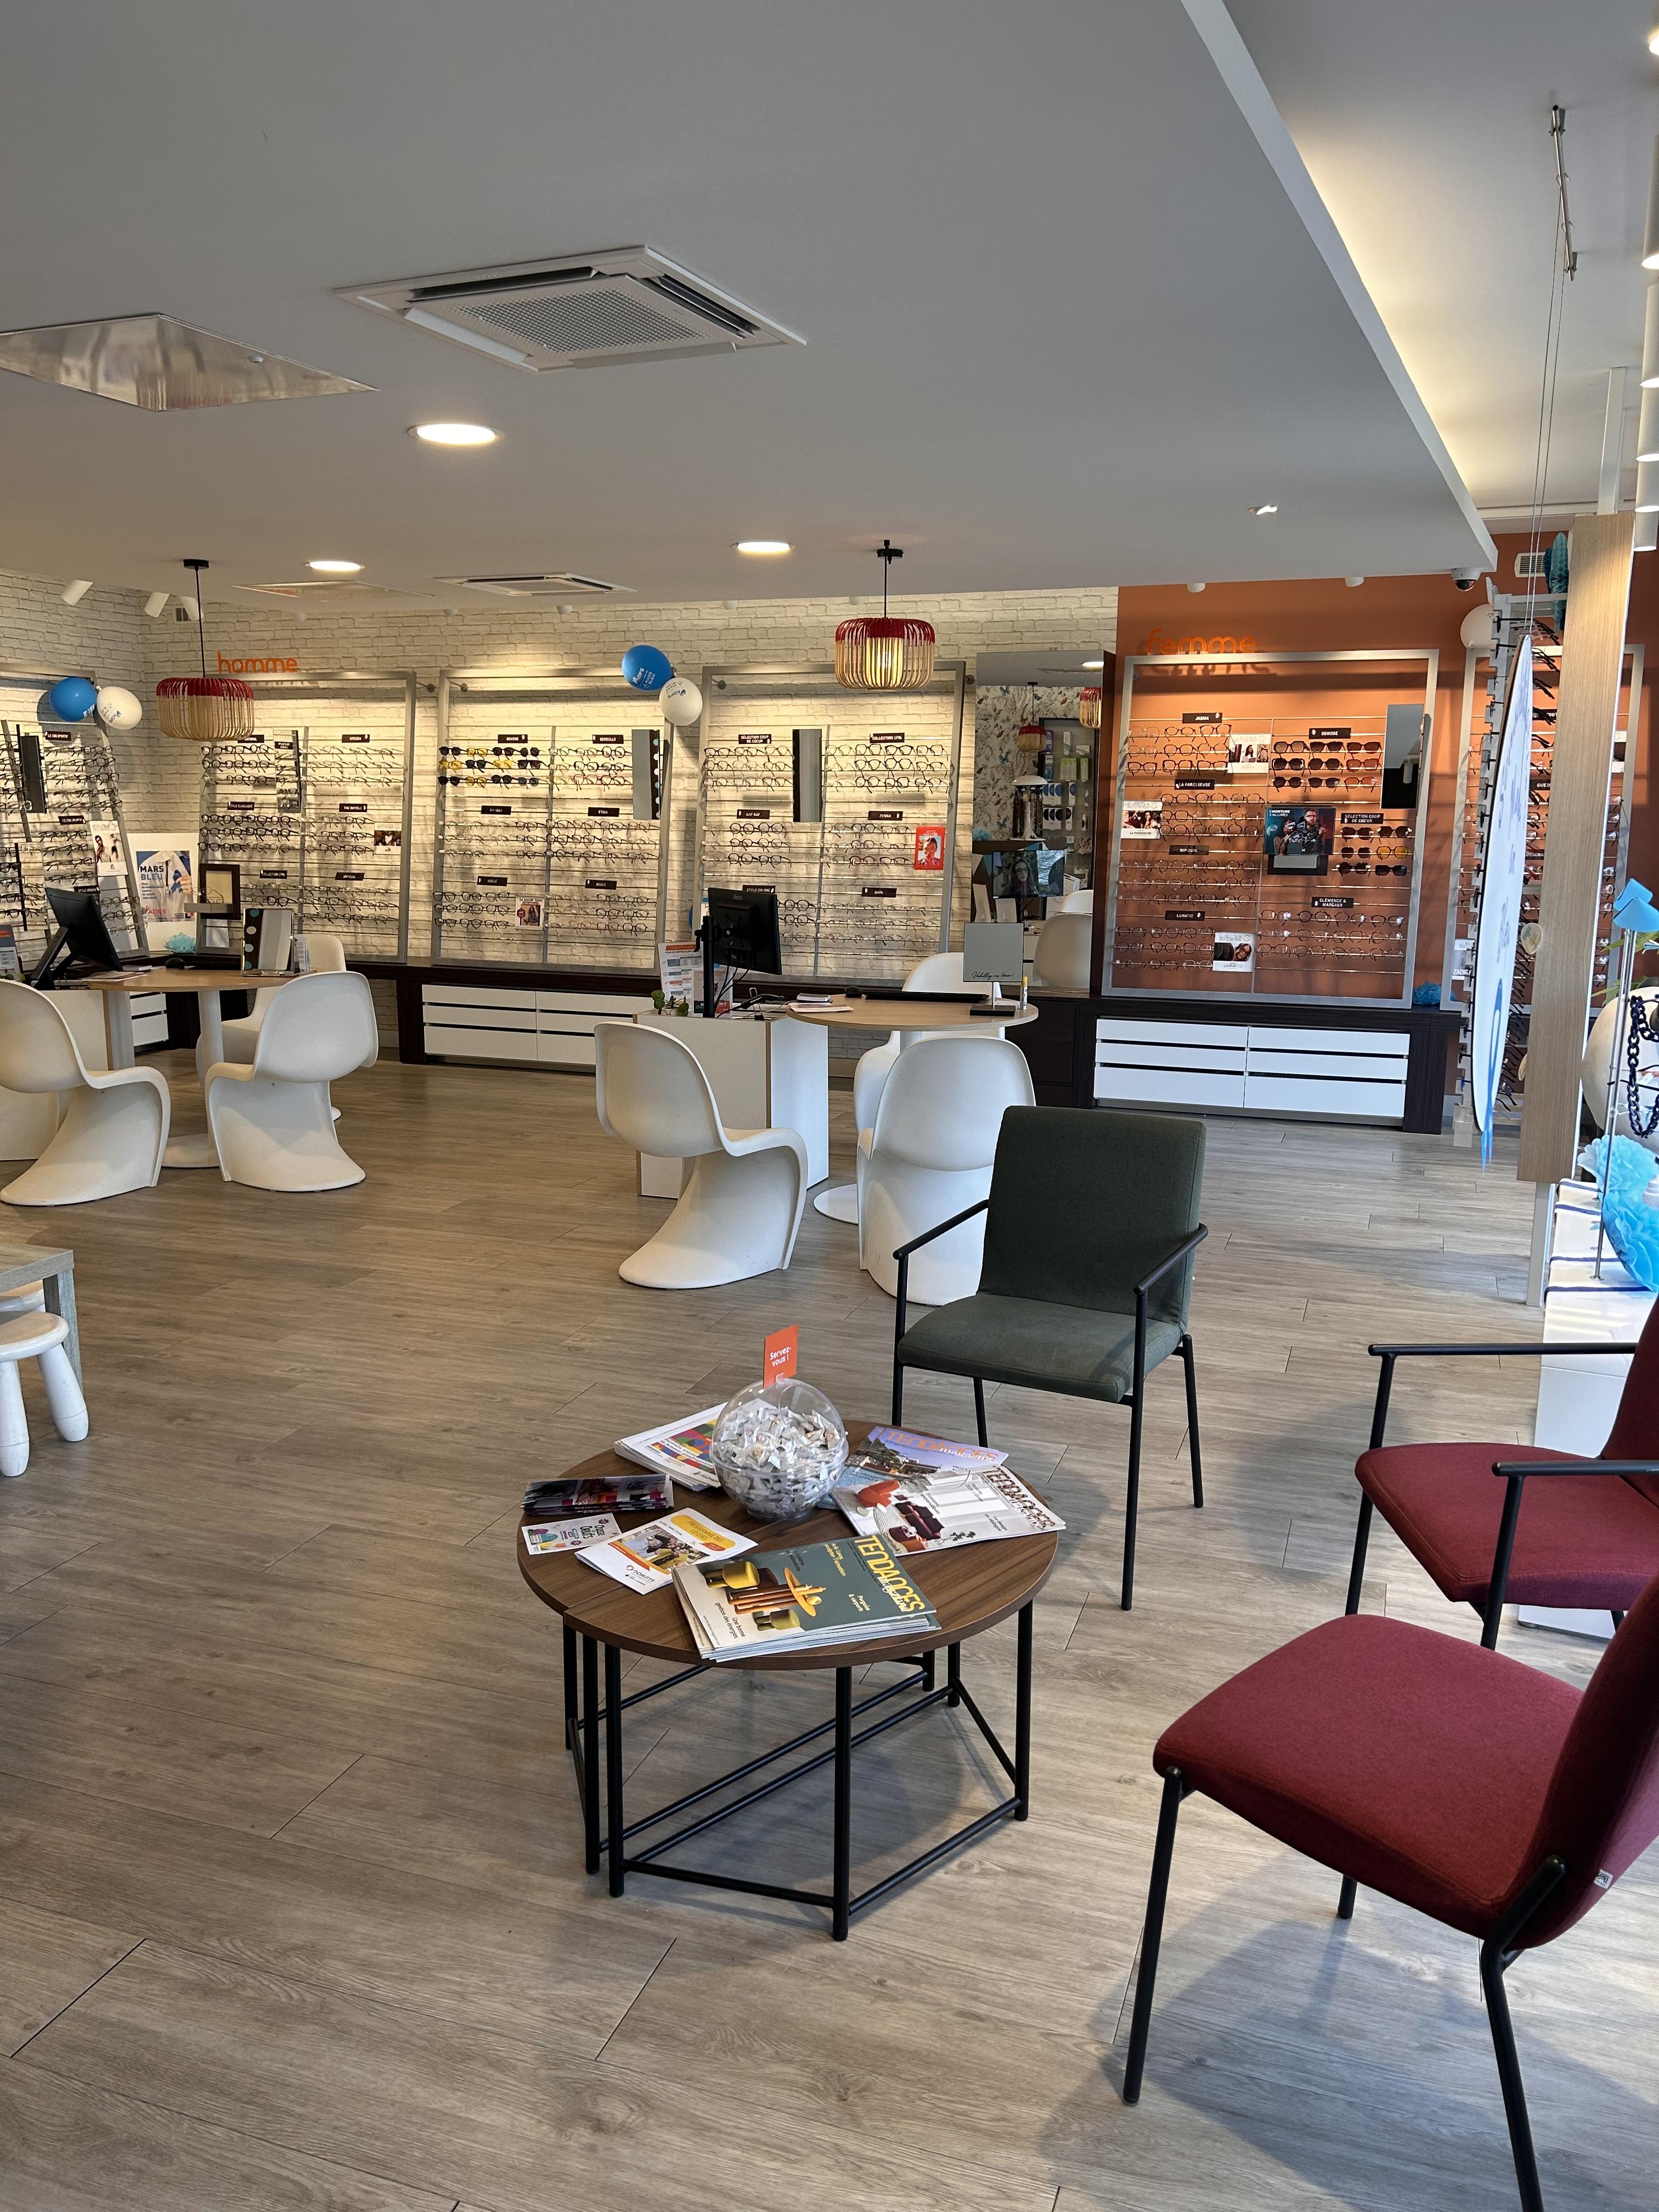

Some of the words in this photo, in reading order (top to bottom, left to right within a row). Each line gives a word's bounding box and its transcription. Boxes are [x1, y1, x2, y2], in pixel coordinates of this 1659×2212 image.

[1147, 628, 1255, 655] femme
[217, 650, 298, 674] homme
[770, 1346, 792, 1360] Servez-
[772, 1356, 786, 1367] vous
[854, 1535, 926, 1612] TENDANCES
[857, 1595, 871, 1611] Pergolas
[877, 1576, 911, 1612] magazine
